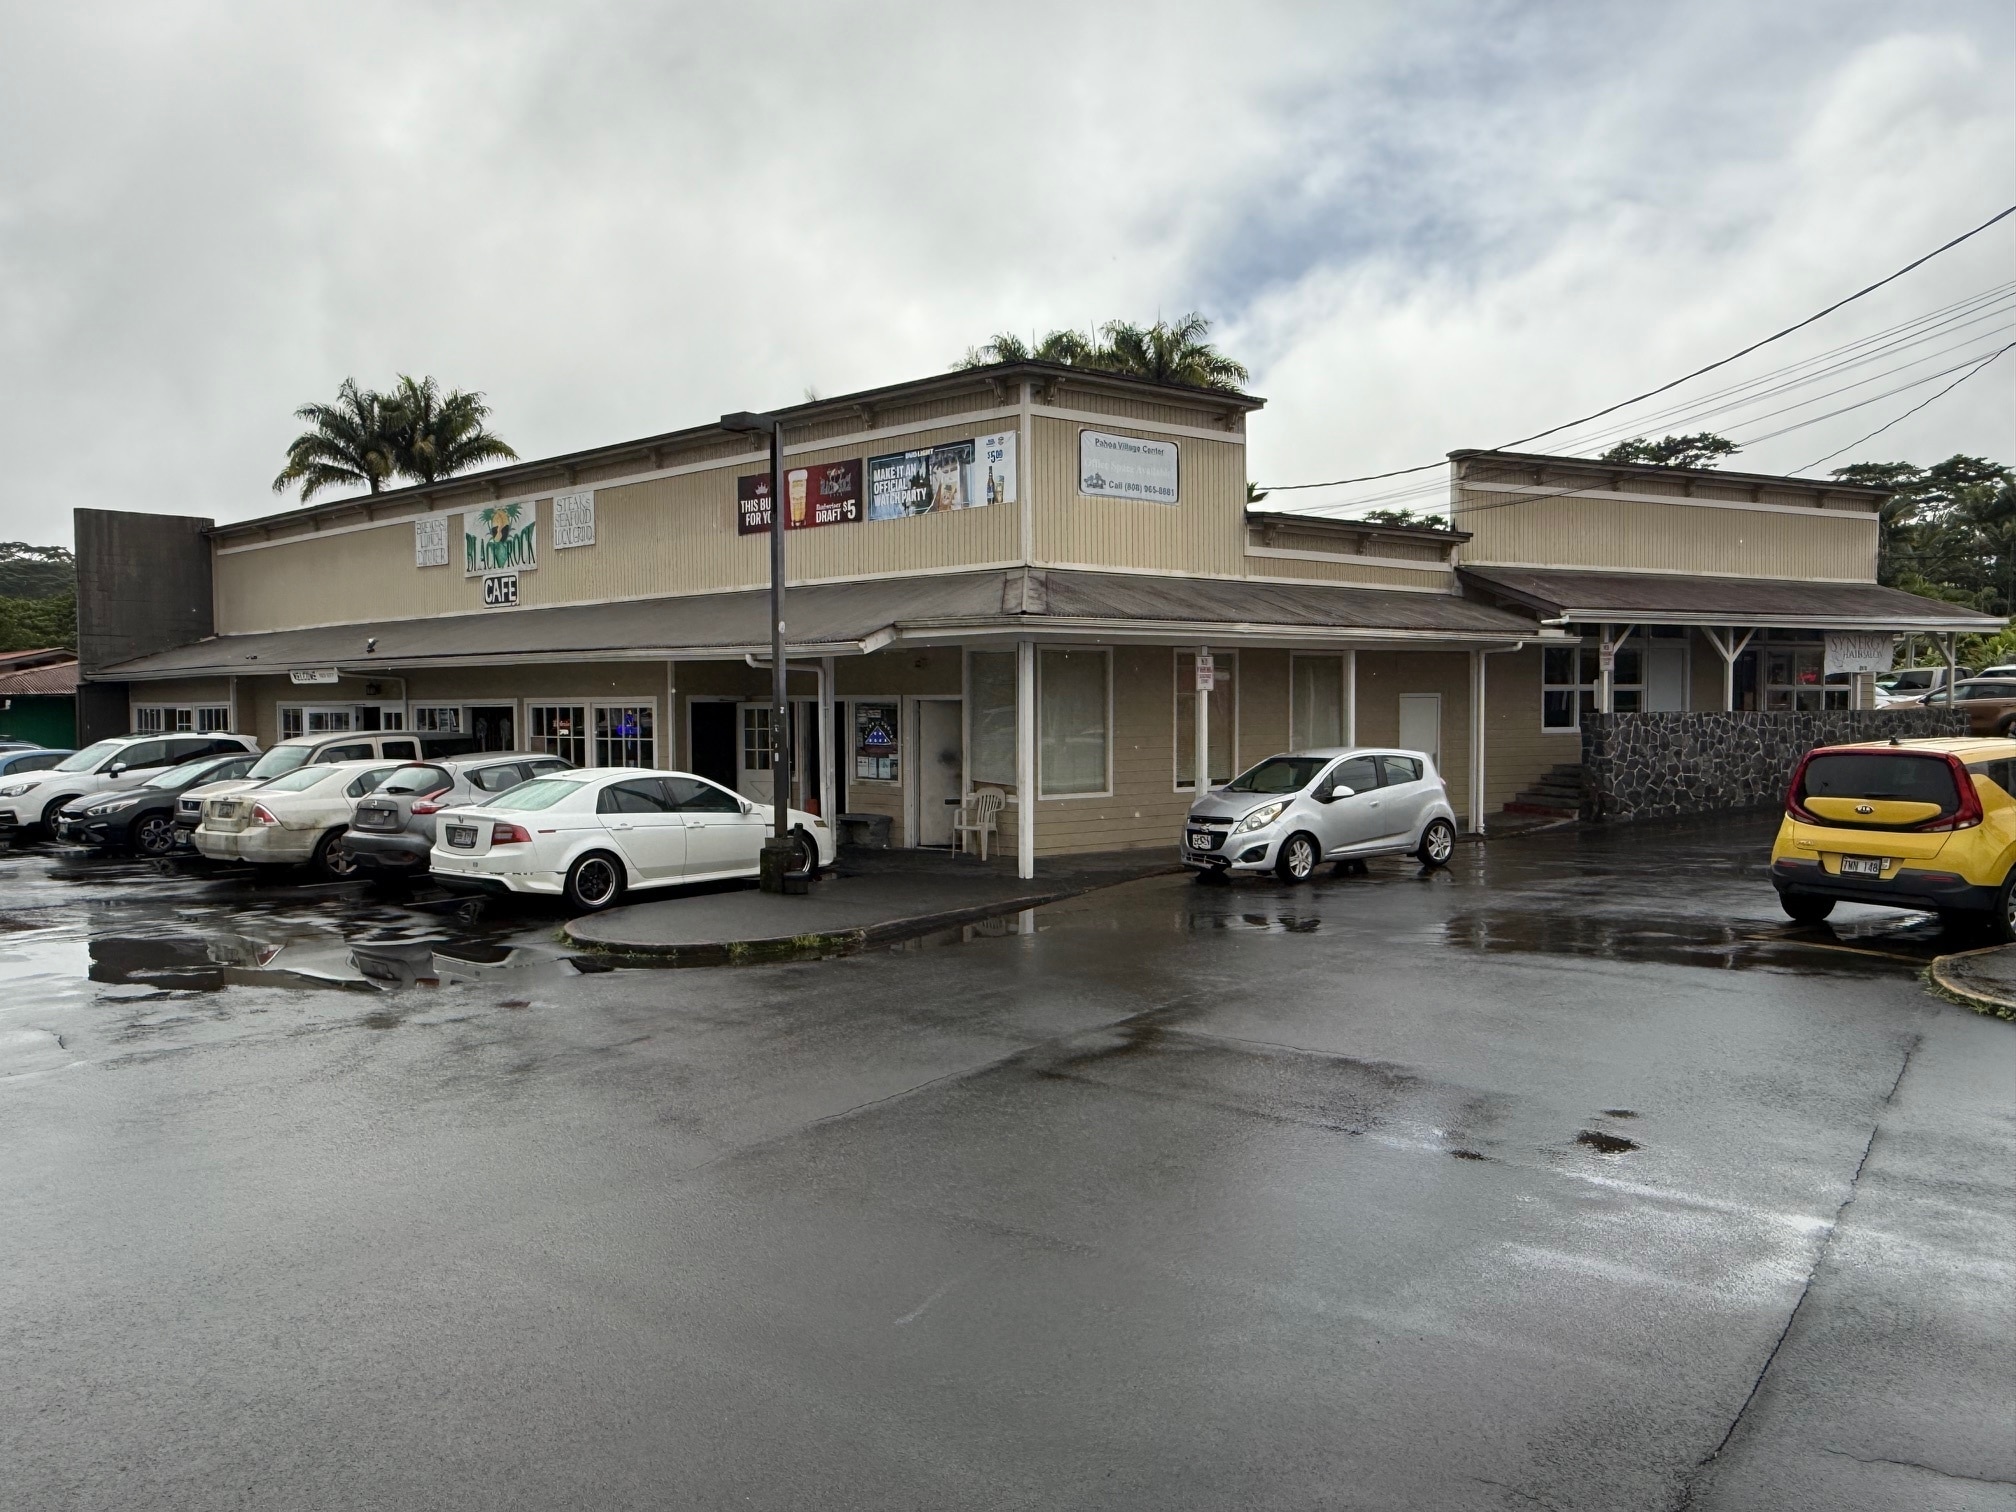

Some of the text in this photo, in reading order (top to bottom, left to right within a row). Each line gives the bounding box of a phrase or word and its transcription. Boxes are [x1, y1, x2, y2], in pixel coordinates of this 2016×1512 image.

[1117, 441, 1141, 453] Village
[1142, 445, 1164, 456] Center
[873, 463, 917, 482] MAKE IT AN
[873, 478, 908, 495] OFFICIAL
[1109, 480, 1123, 490] Call
[557, 494, 591, 512] STEAKS
[873, 487, 927, 507] WATCH PARTY
[740, 499, 758, 513] THIS
[842, 499, 856, 519] $5
[555, 509, 592, 528] SEAFOOD
[746, 512, 761, 526] FOR
[816, 508, 841, 523] DRAFT
[507, 521, 536, 568] ROCK
[485, 577, 517, 603] CAFE
[1831, 635, 1887, 652] SYNERGY
